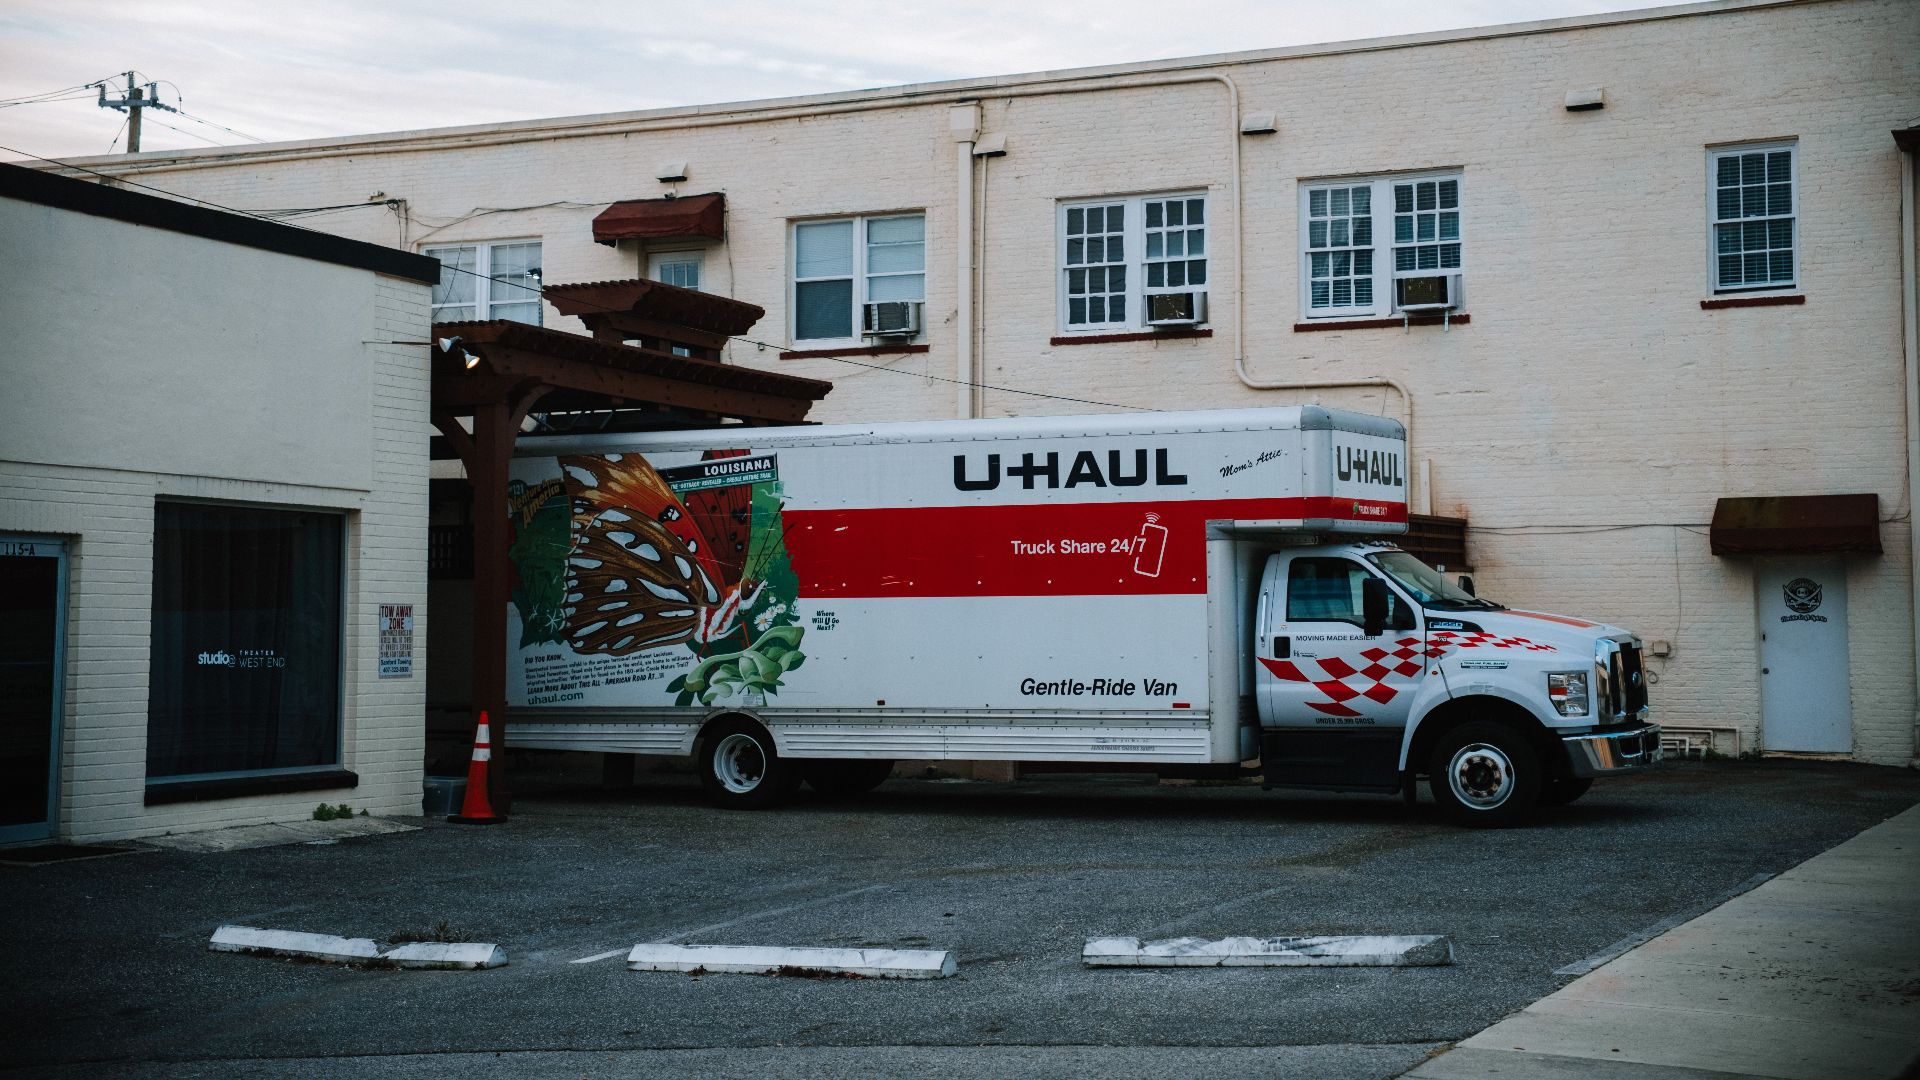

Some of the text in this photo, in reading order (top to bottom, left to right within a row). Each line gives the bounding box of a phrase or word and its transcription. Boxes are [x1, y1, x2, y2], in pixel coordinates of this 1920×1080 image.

[704, 459, 771, 476] LOUISIANA
[953, 447, 1188, 491] U-HAUL
[1219, 449, 1282, 478] Mom's Attic
[1336, 445, 1403, 487] U-HAUL
[5, 543, 36, 556] 115-A
[1010, 535, 1147, 556] Truck Share 24/7
[381, 605, 413, 618] TOW AWAY
[388, 617, 404, 630] ZONE
[824, 617, 831, 626] U
[239, 657, 285, 668] WEST END
[535, 655, 546, 664] YOU
[560, 682, 577, 690] ABOUT
[578, 680, 591, 688] THIS
[632, 674, 647, 682] ROAD
[1020, 677, 1178, 697] Gentle-Ride Van
[527, 691, 584, 706] uhaul.com
[1315, 717, 1336, 725] UNDER
[1354, 717, 1376, 725] GROSS
